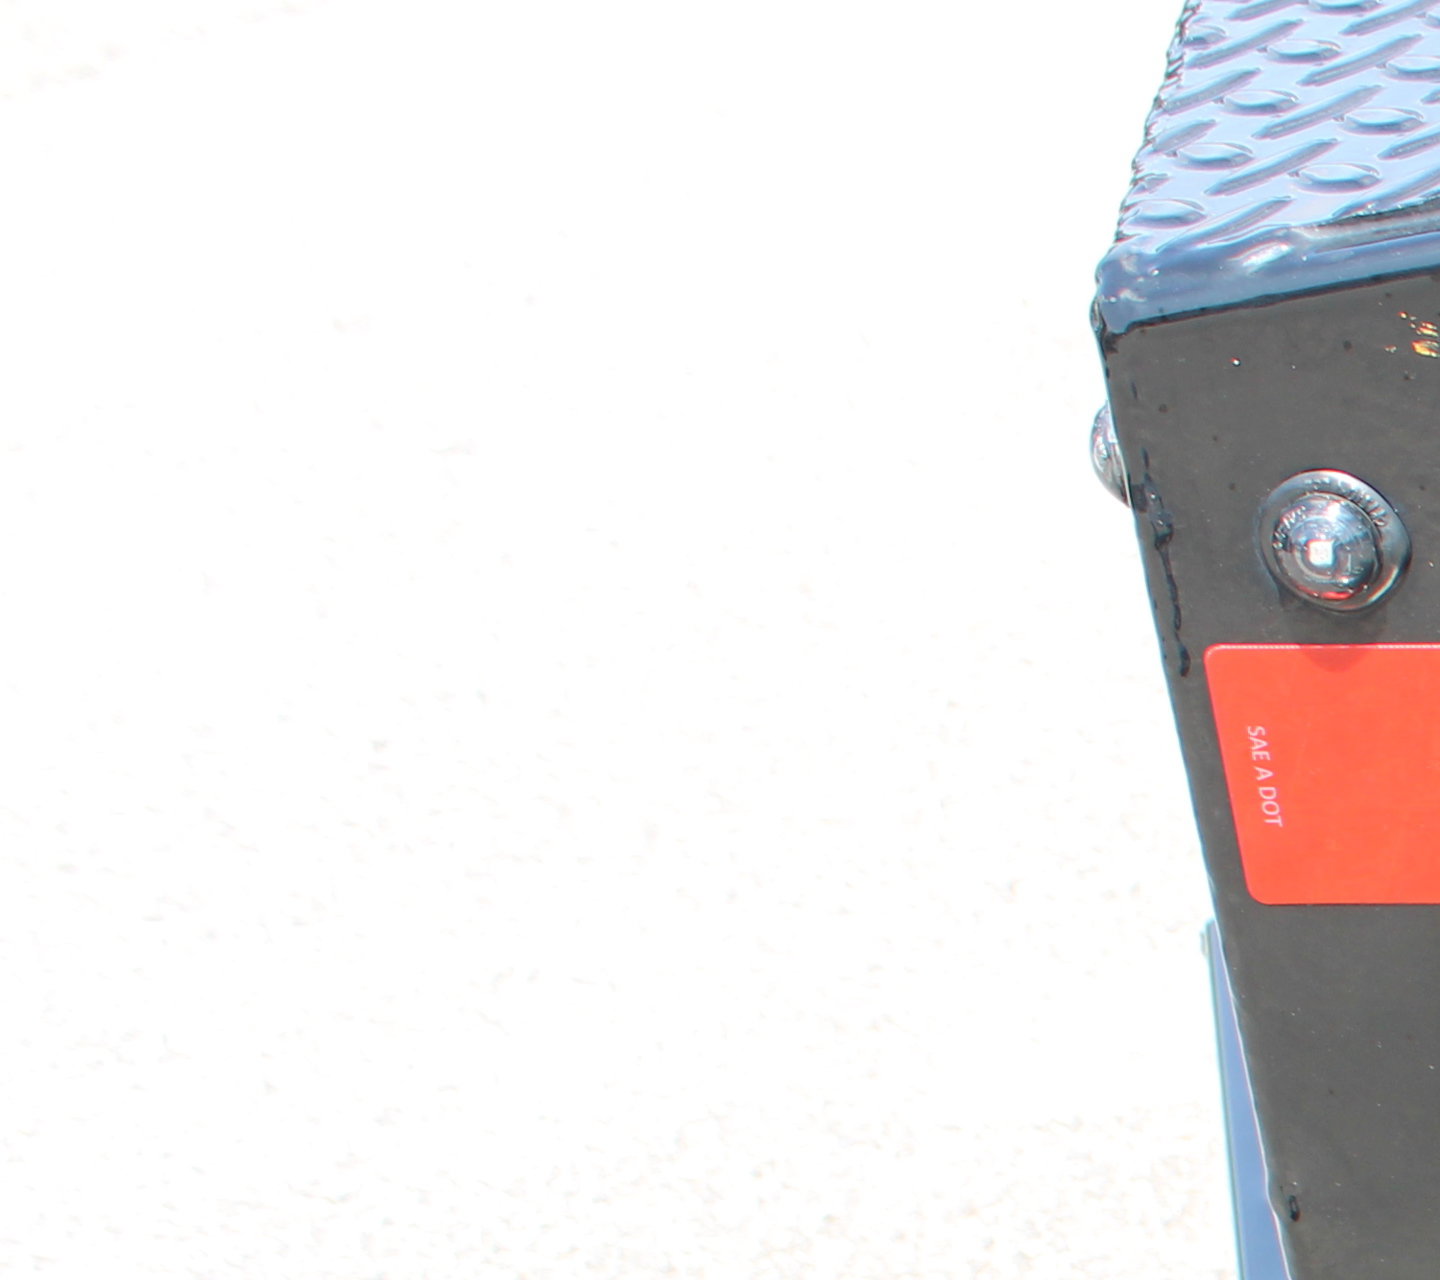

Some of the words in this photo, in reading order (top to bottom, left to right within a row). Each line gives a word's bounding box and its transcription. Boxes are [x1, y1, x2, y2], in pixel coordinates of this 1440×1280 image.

[1247, 725, 1271, 761] SAE
[1253, 765, 1275, 781] A
[1258, 786, 1284, 828] DOT
